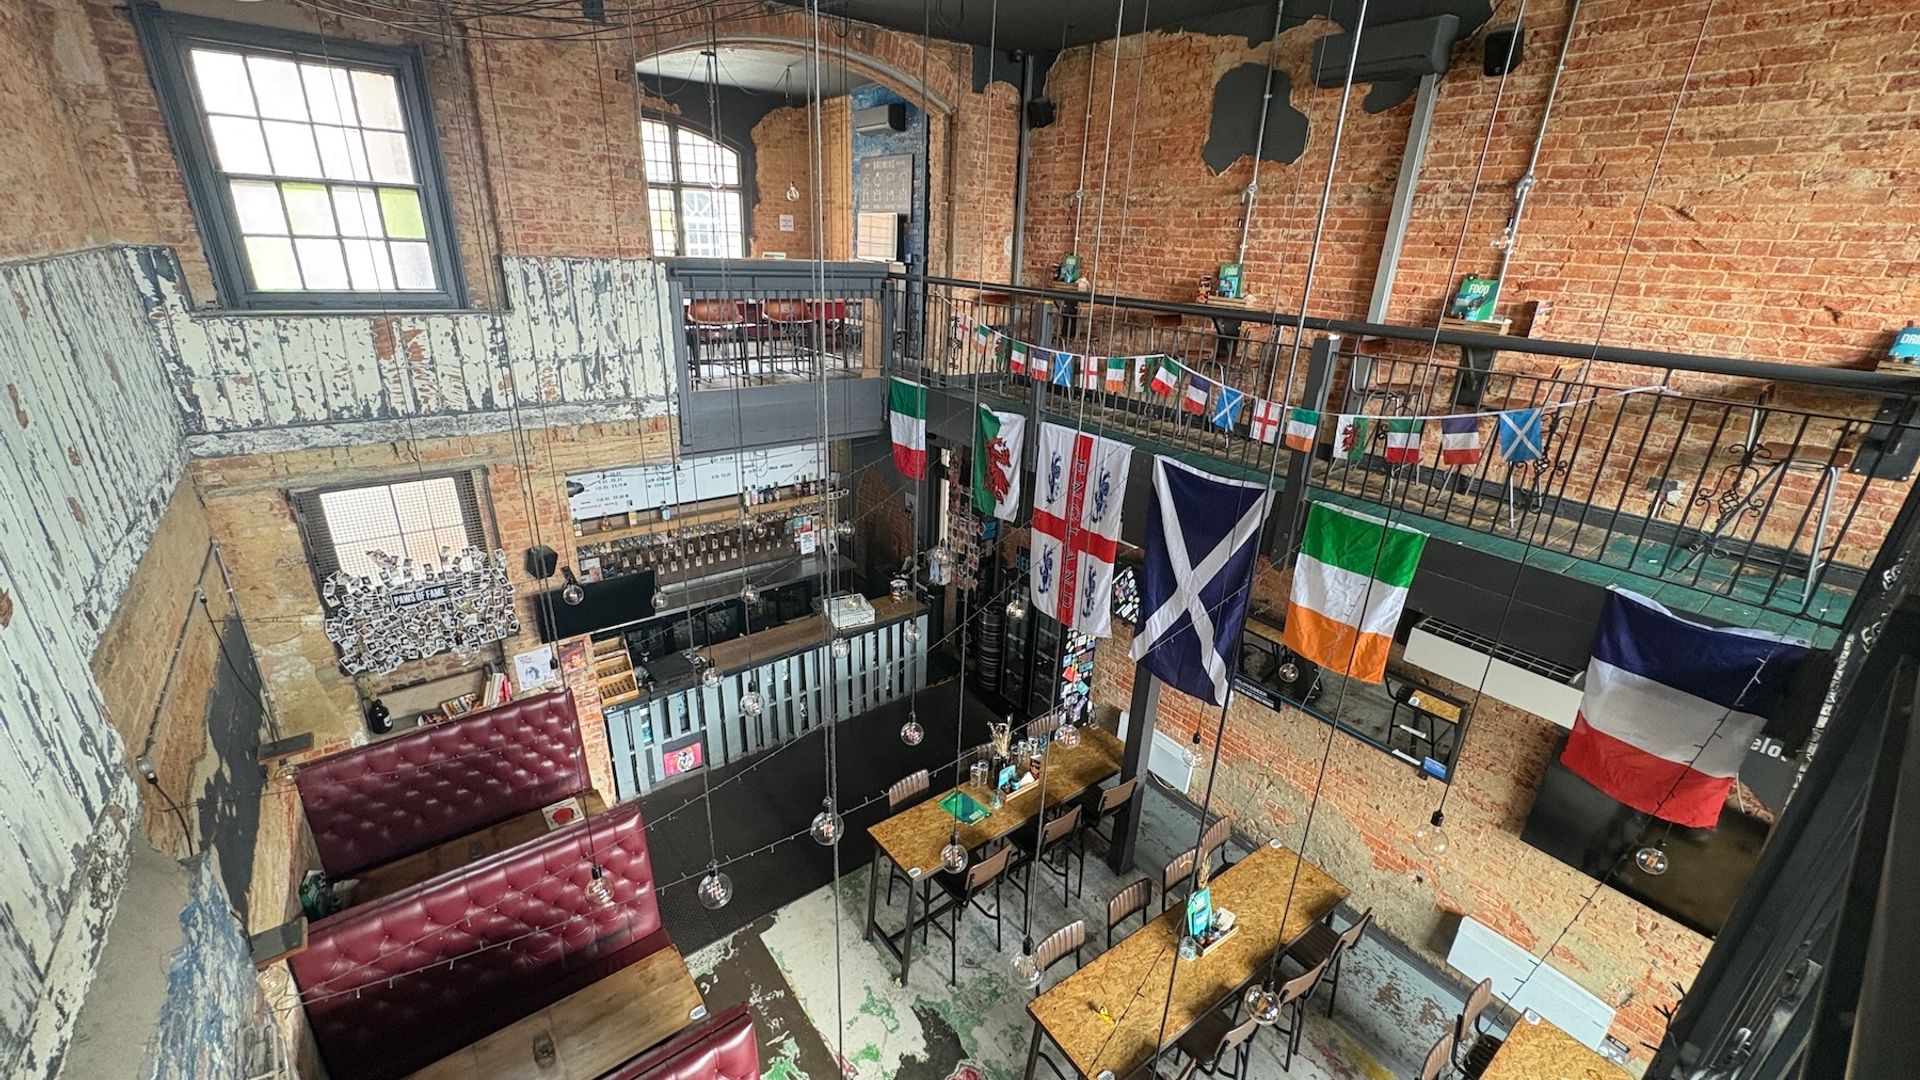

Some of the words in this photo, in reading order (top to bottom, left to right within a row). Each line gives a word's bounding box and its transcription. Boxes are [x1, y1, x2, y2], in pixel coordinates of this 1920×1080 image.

[1468, 283, 1490, 297] FOOD
[1062, 459, 1087, 609] ENGLAND
[393, 593, 416, 606] PAWS
[415, 589, 427, 602] OF
[425, 586, 445, 600] FAME
